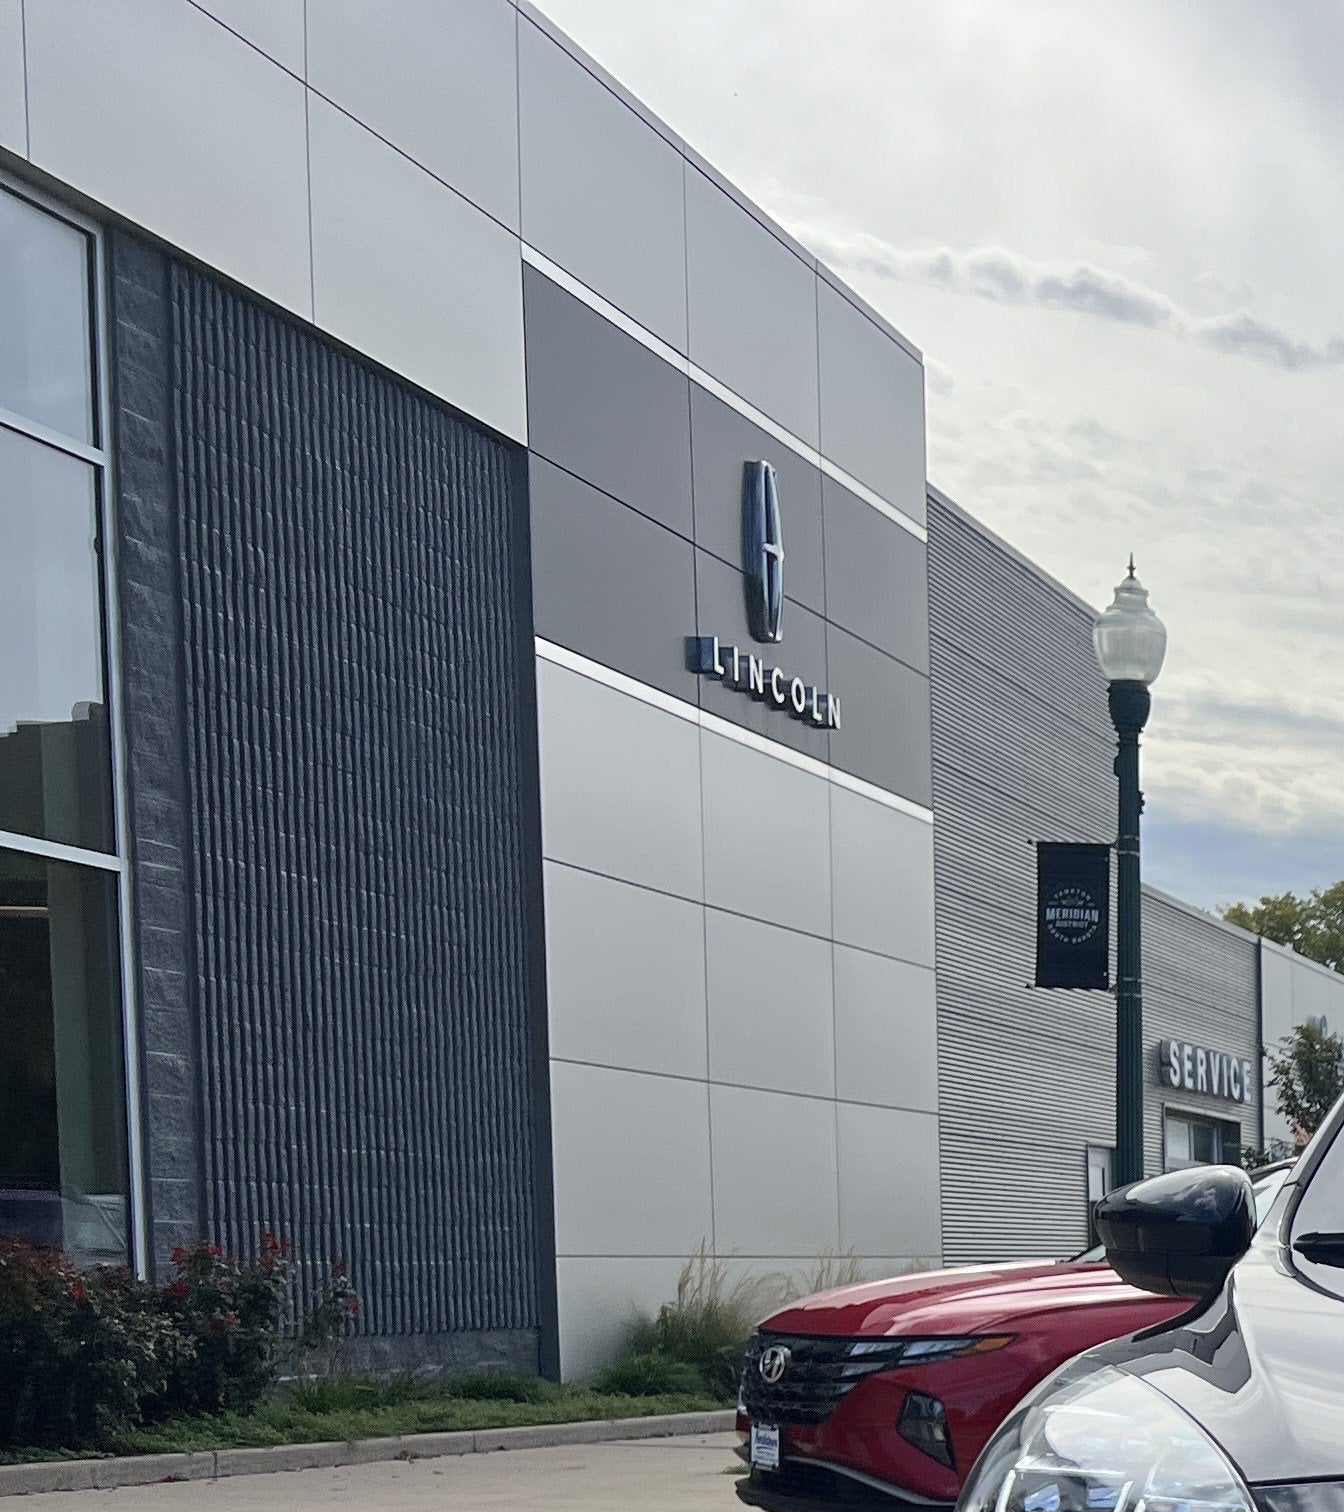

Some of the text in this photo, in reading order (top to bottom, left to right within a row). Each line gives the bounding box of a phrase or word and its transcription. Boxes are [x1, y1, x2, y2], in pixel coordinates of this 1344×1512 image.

[713, 636, 841, 730] LINCOLN
[1045, 907, 1099, 922] MERIDIAN
[1168, 1040, 1251, 1101] SERVICE
